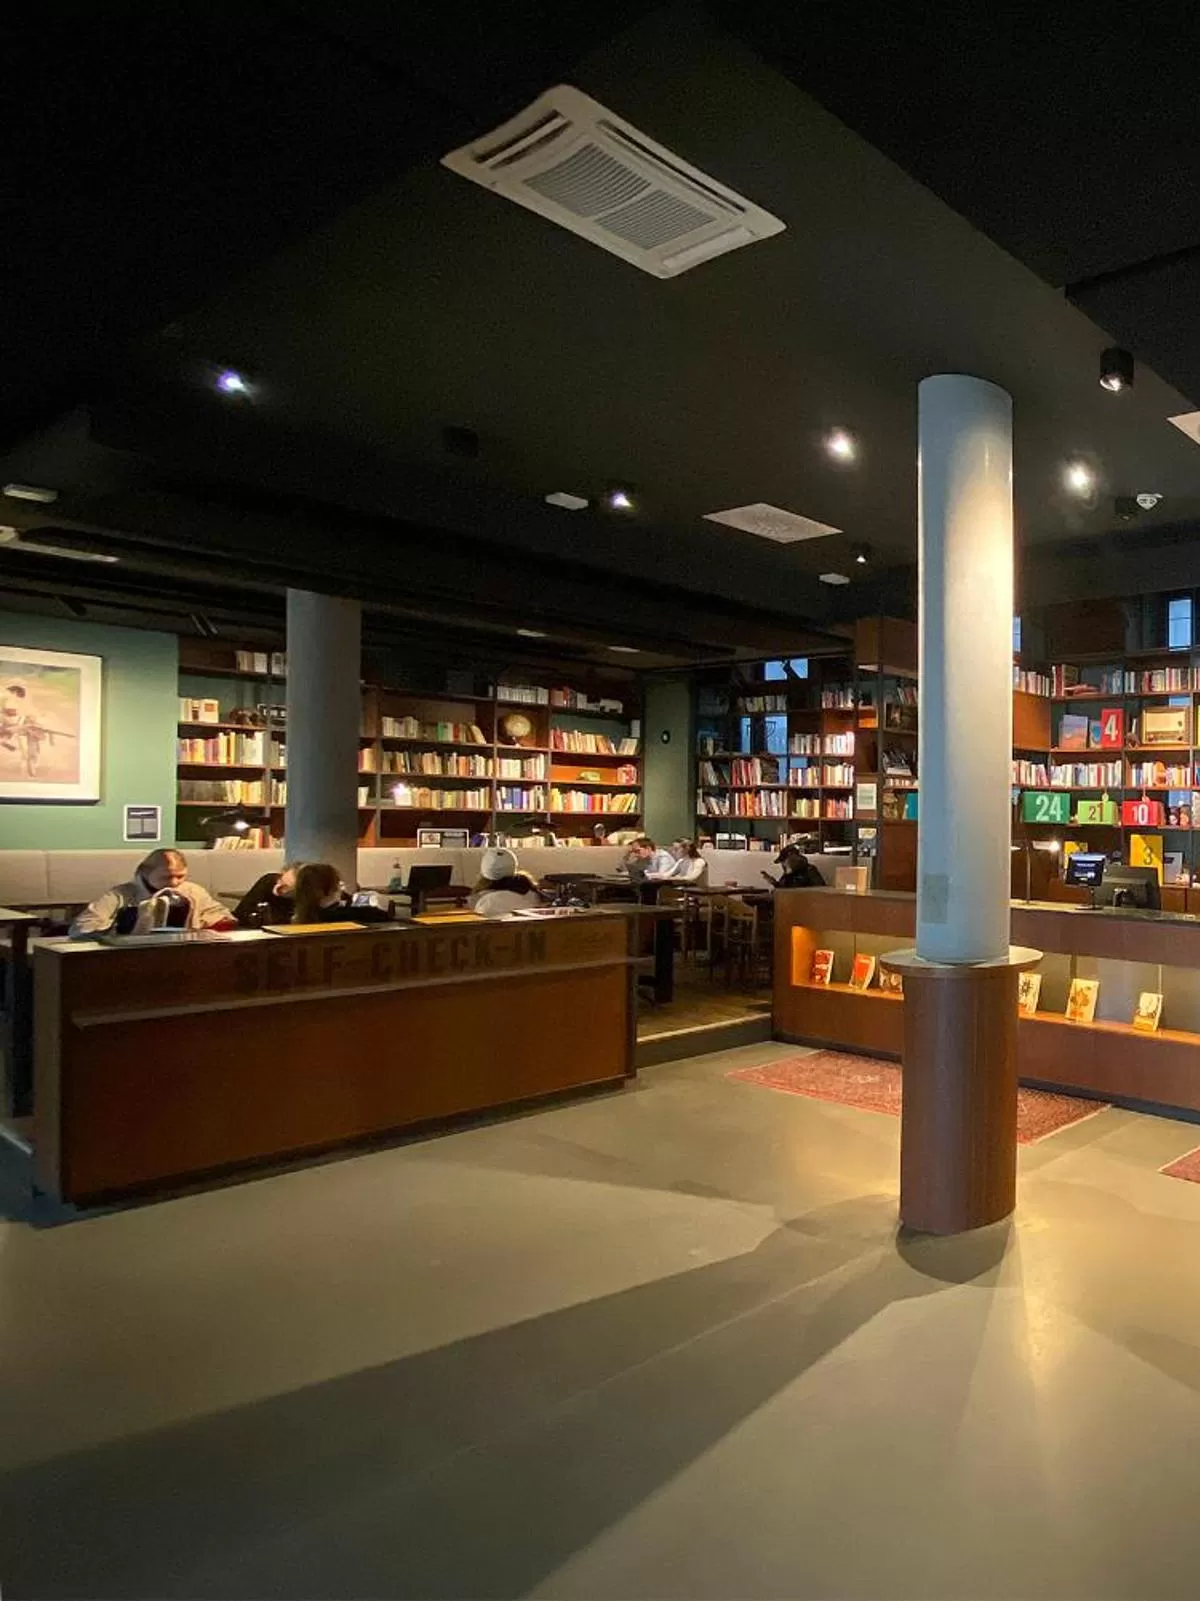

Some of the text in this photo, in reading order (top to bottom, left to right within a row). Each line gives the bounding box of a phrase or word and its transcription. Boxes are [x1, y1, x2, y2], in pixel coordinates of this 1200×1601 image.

[1104, 714, 1118, 741] 4
[1036, 795, 1062, 822] 24
[1089, 799, 1104, 823] 21
[1133, 801, 1149, 822] 10
